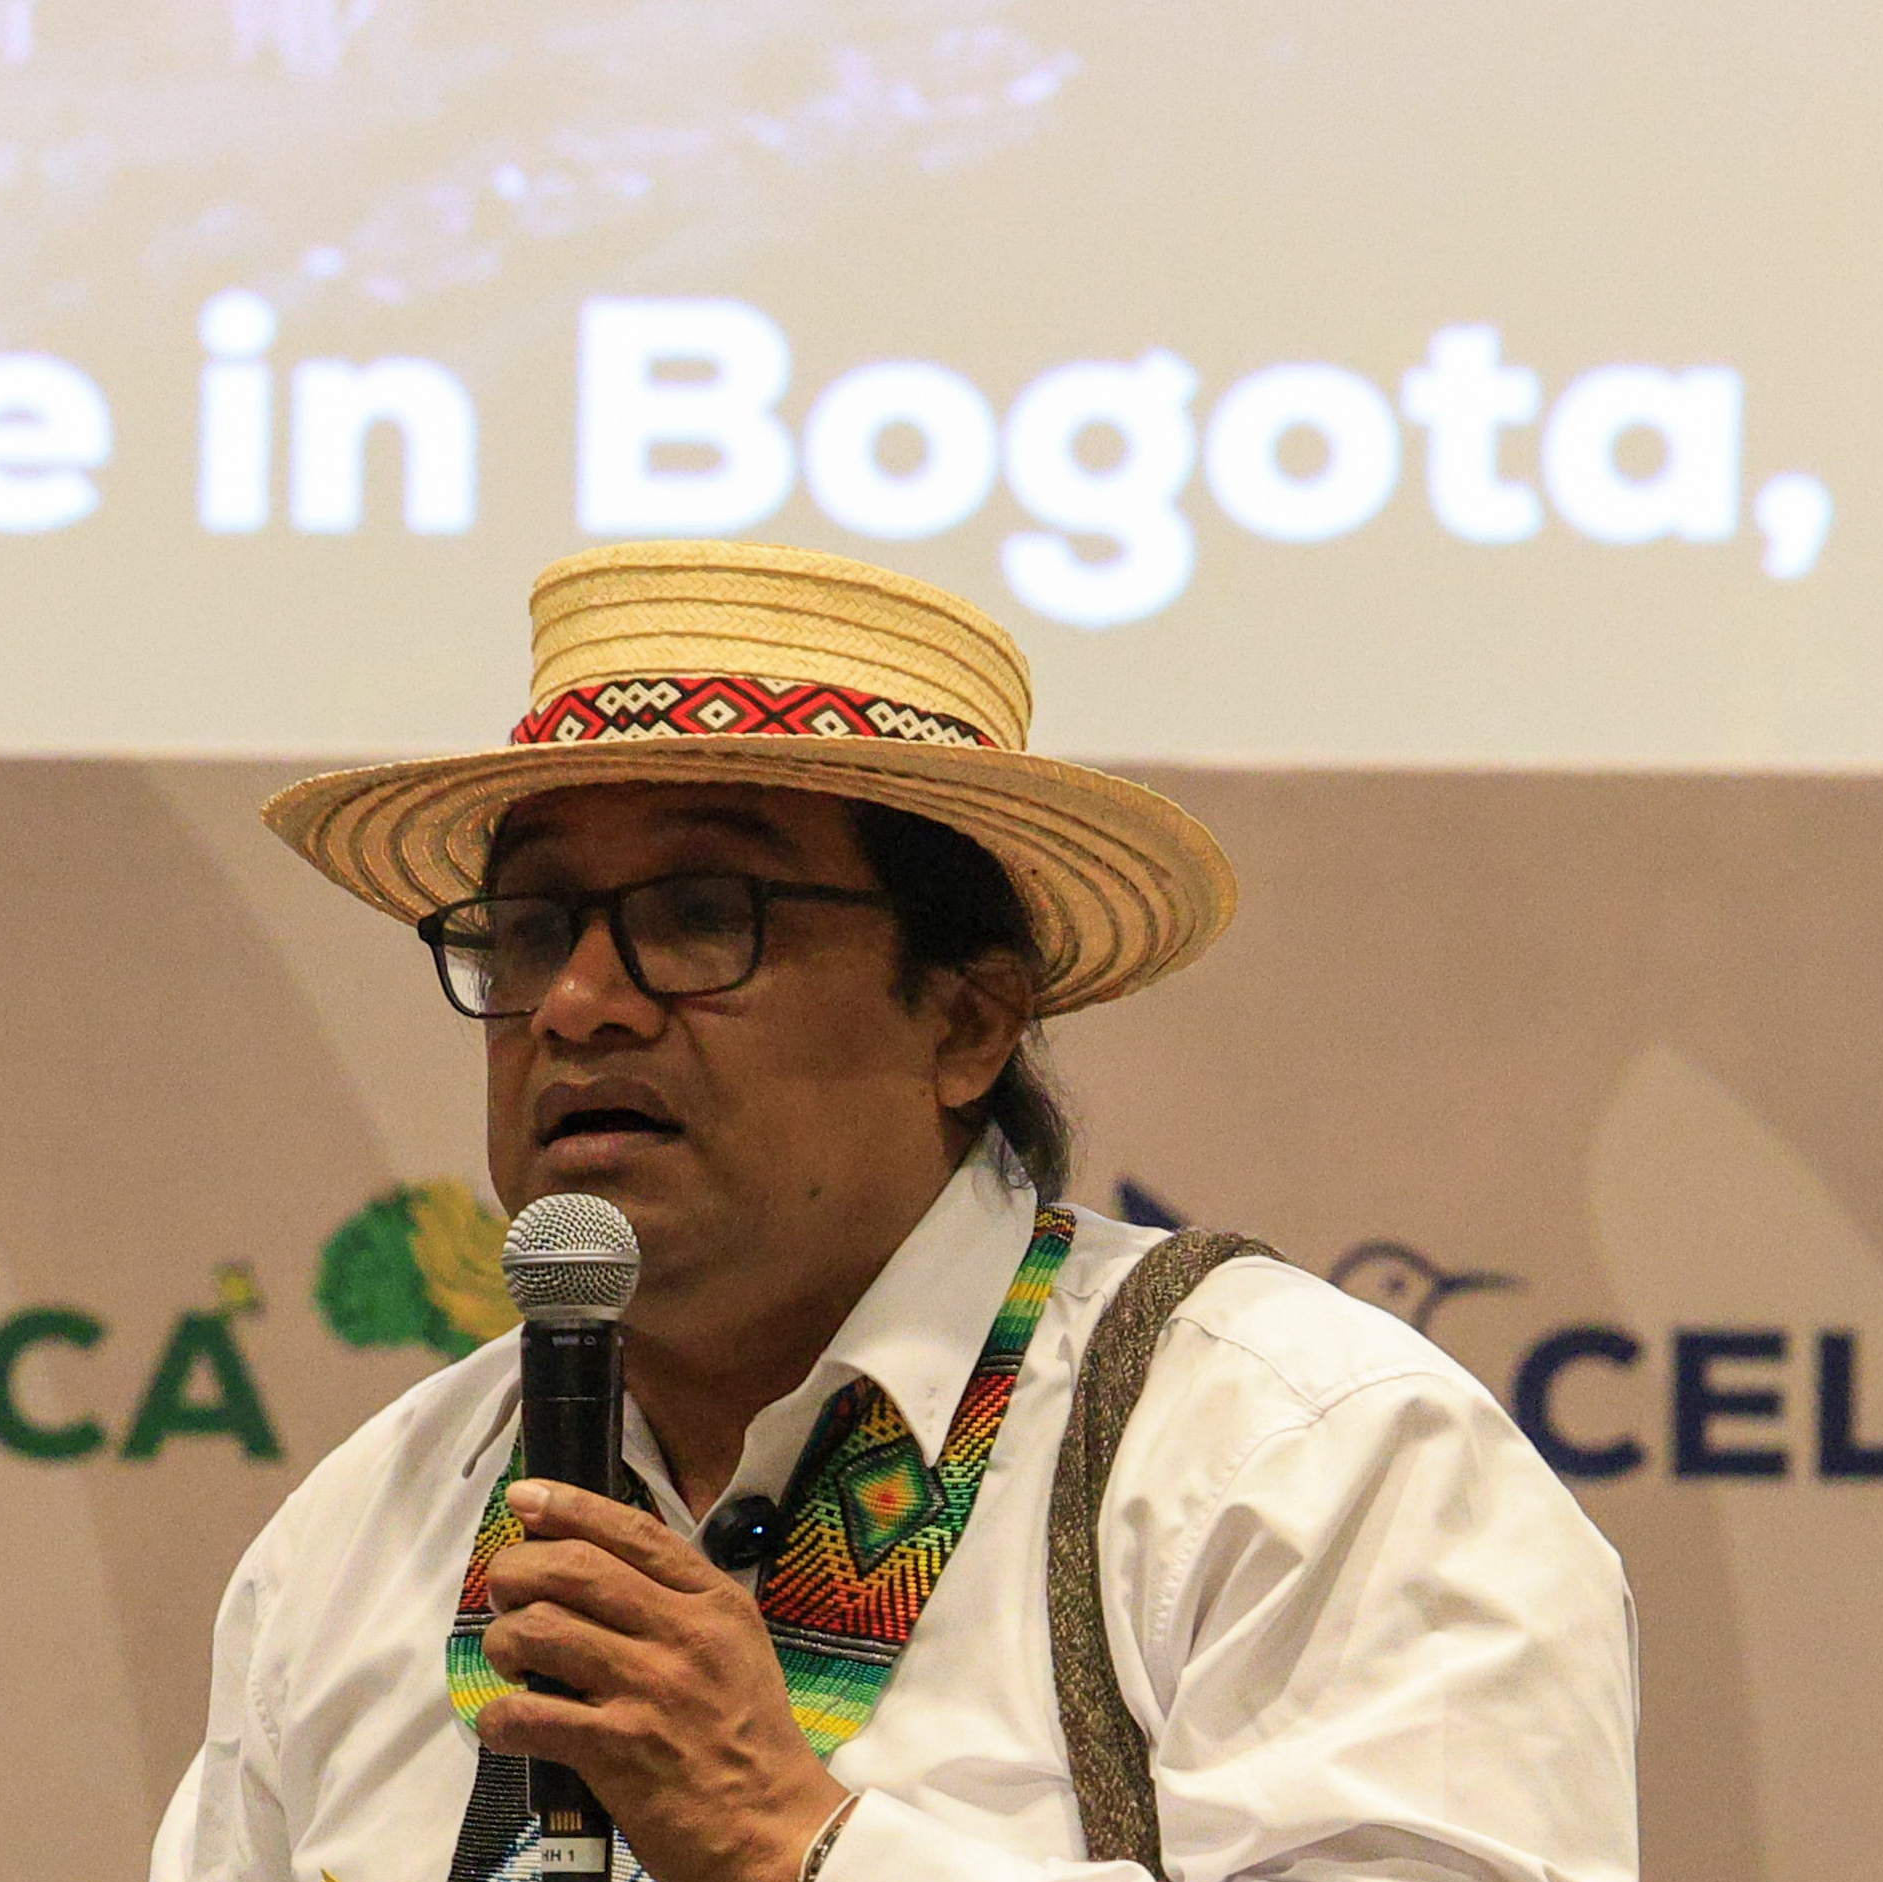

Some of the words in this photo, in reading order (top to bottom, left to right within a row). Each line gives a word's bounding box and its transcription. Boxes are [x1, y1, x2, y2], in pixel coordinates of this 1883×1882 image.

[202, 293, 474, 532] in
[577, 298, 1830, 622] Bogota,
[567, 1849, 574, 1862] 1
